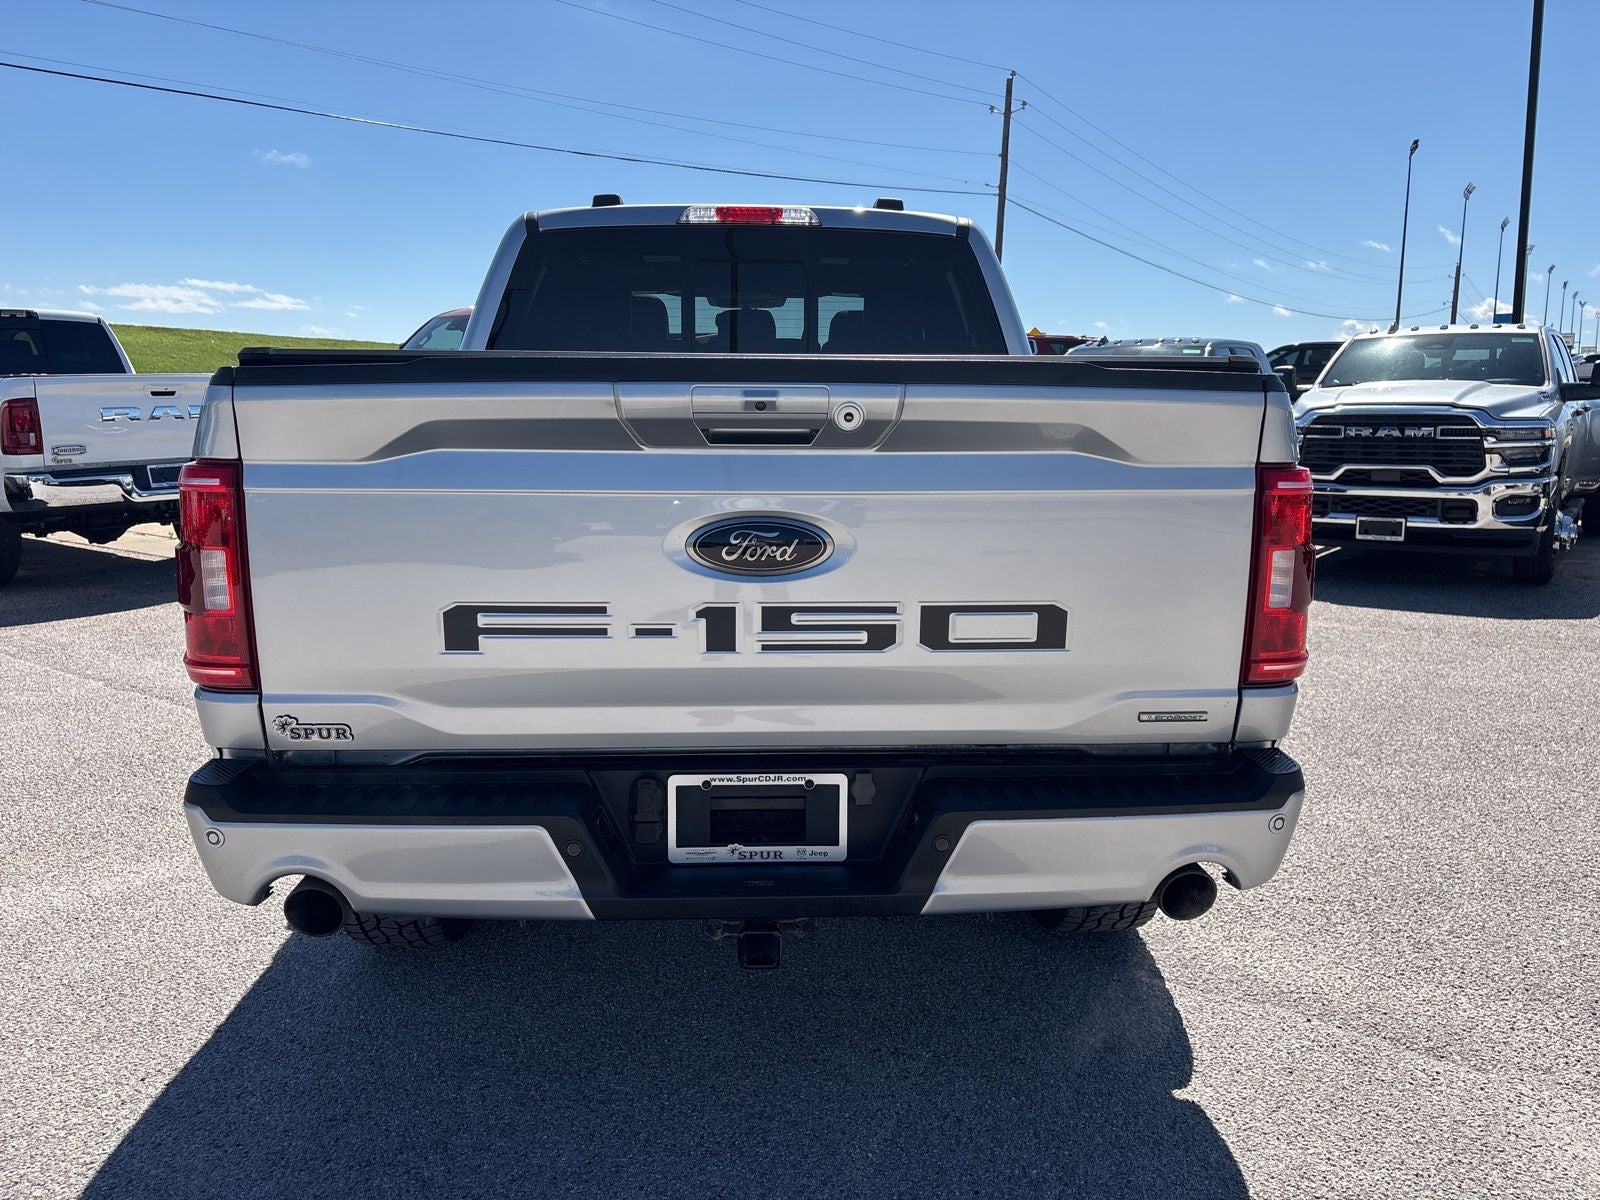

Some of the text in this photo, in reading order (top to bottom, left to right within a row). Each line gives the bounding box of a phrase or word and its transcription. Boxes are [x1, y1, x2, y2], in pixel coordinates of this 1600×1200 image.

[1346, 426, 1434, 438] RAM
[721, 529, 799, 561] Ford
[440, 601, 1070, 655] F-150
[289, 727, 349, 740] SPUR
[709, 775, 807, 784] www.SpurCDJR.com
[738, 850, 784, 860] SPUR
